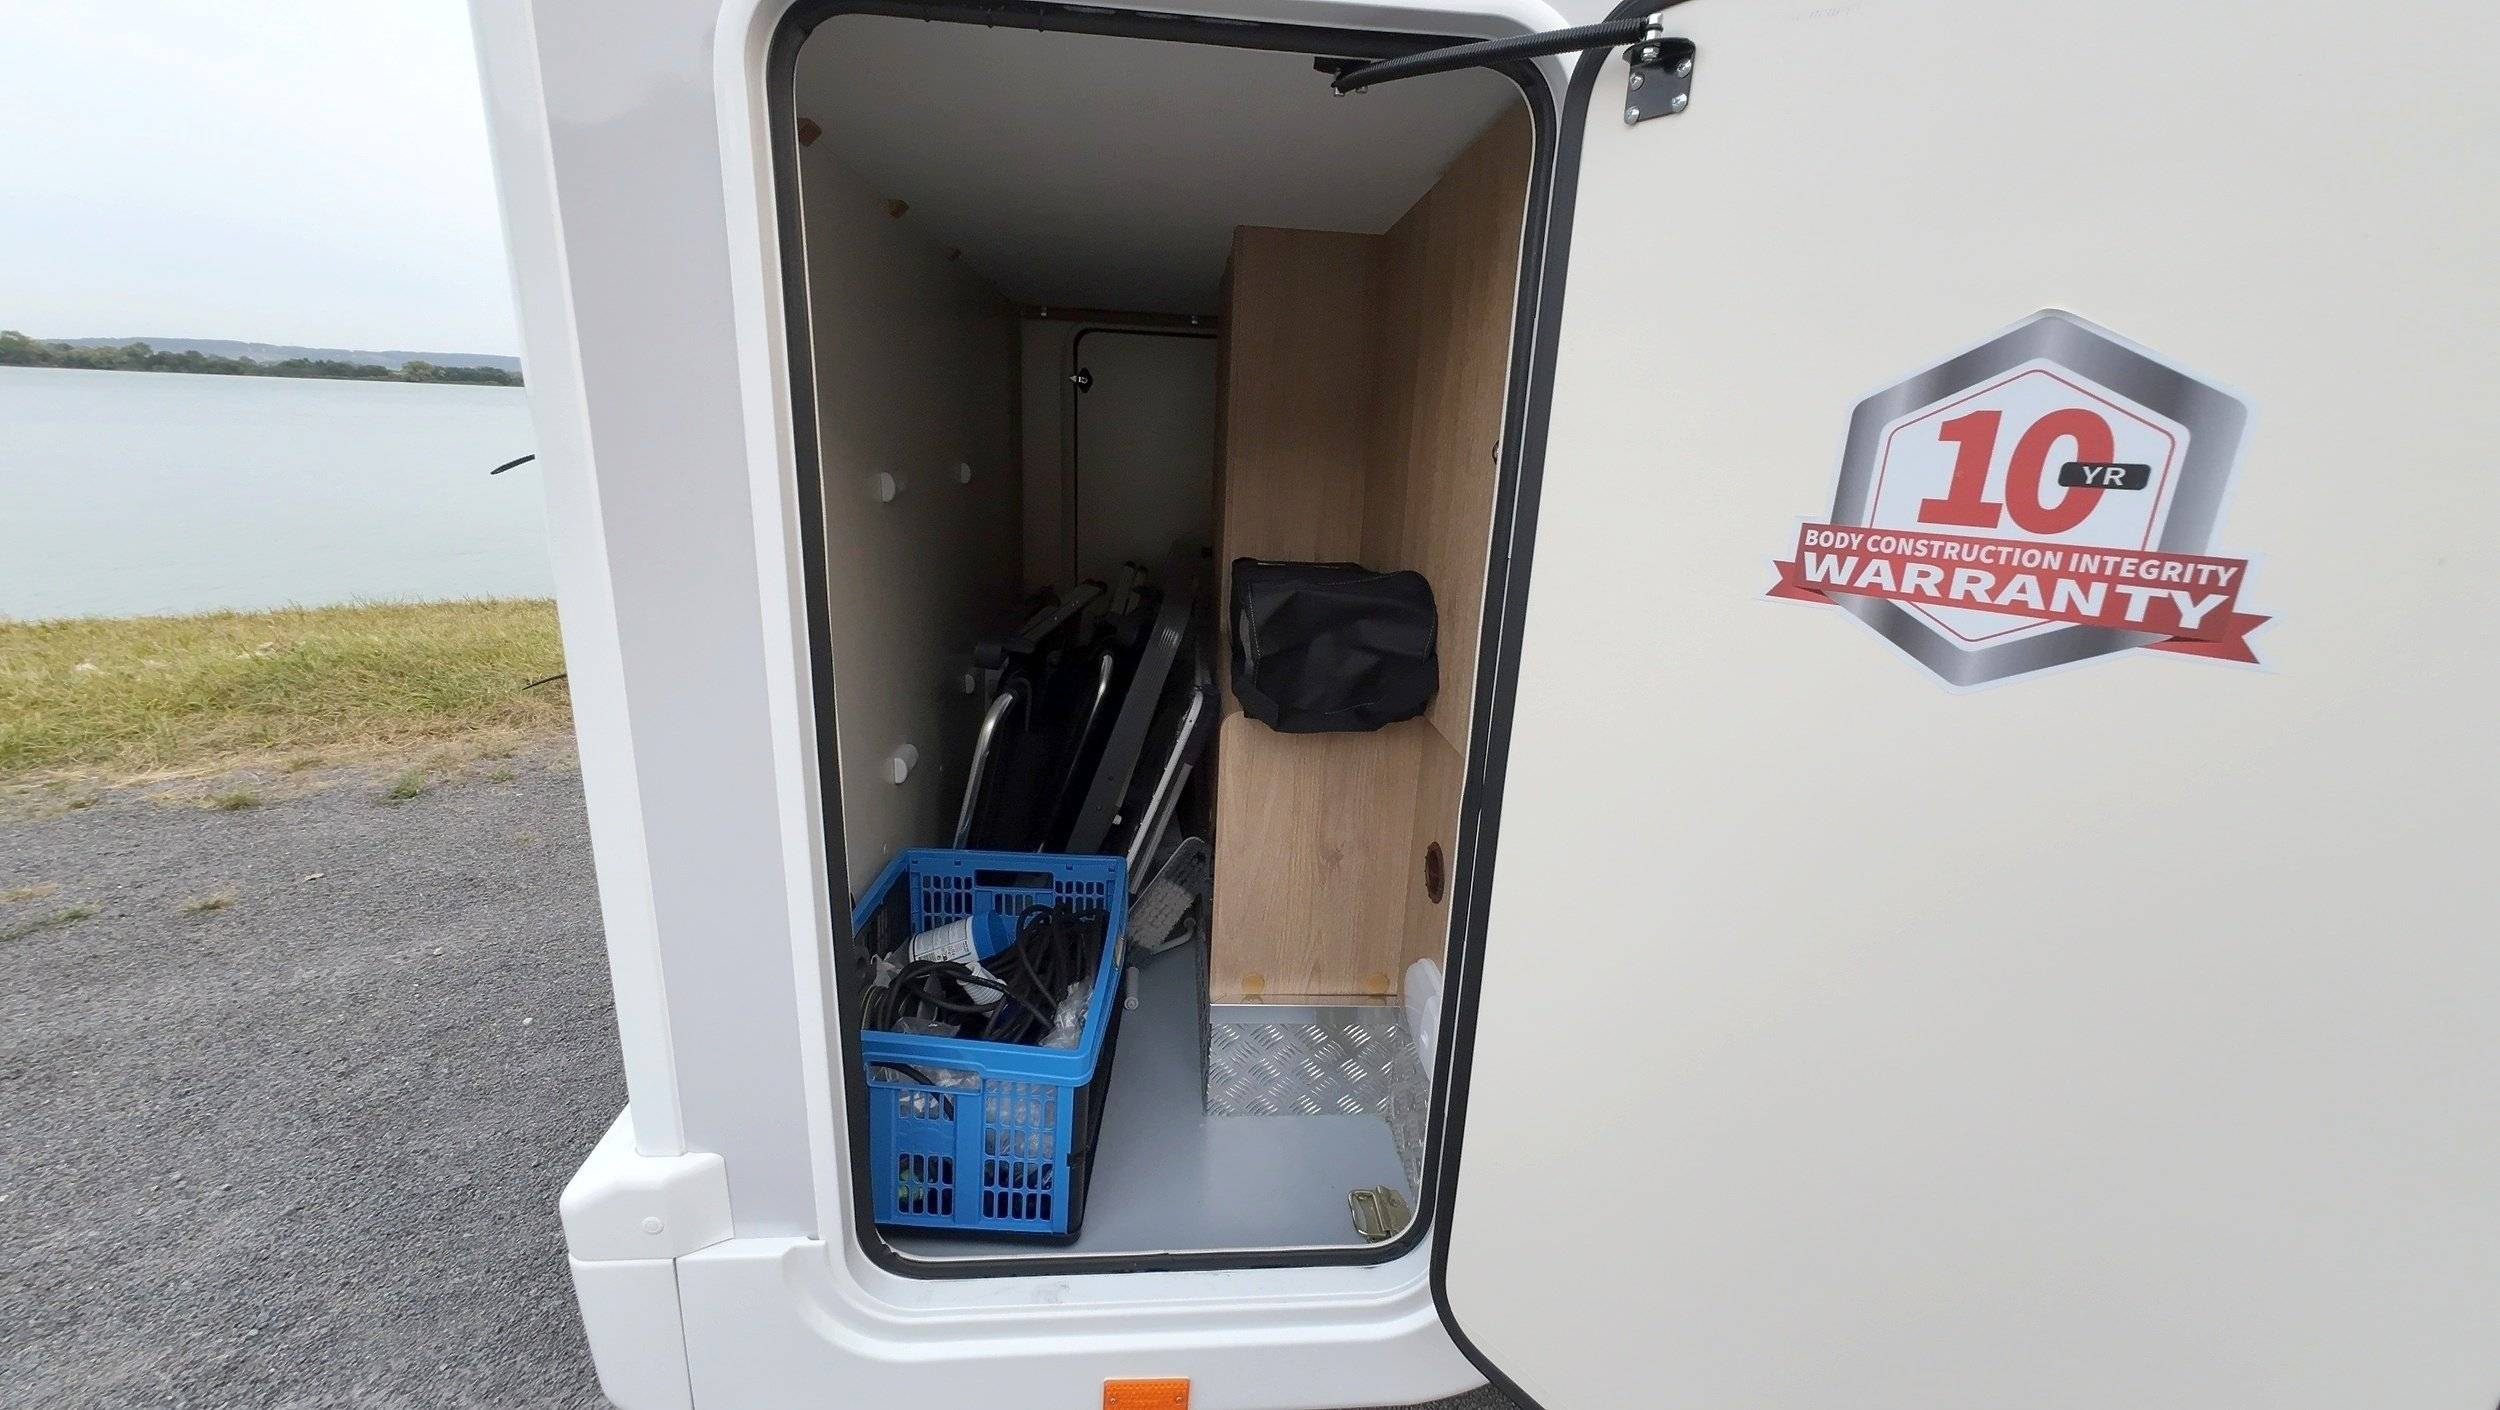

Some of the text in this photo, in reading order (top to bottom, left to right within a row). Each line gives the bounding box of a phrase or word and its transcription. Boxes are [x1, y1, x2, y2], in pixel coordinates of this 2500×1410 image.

[1917, 407, 2127, 535] 10 YR
[1802, 551, 2231, 630] WARRANTY
[1805, 529, 2239, 588] BODY CONSTRUCTION INTEGRITY
